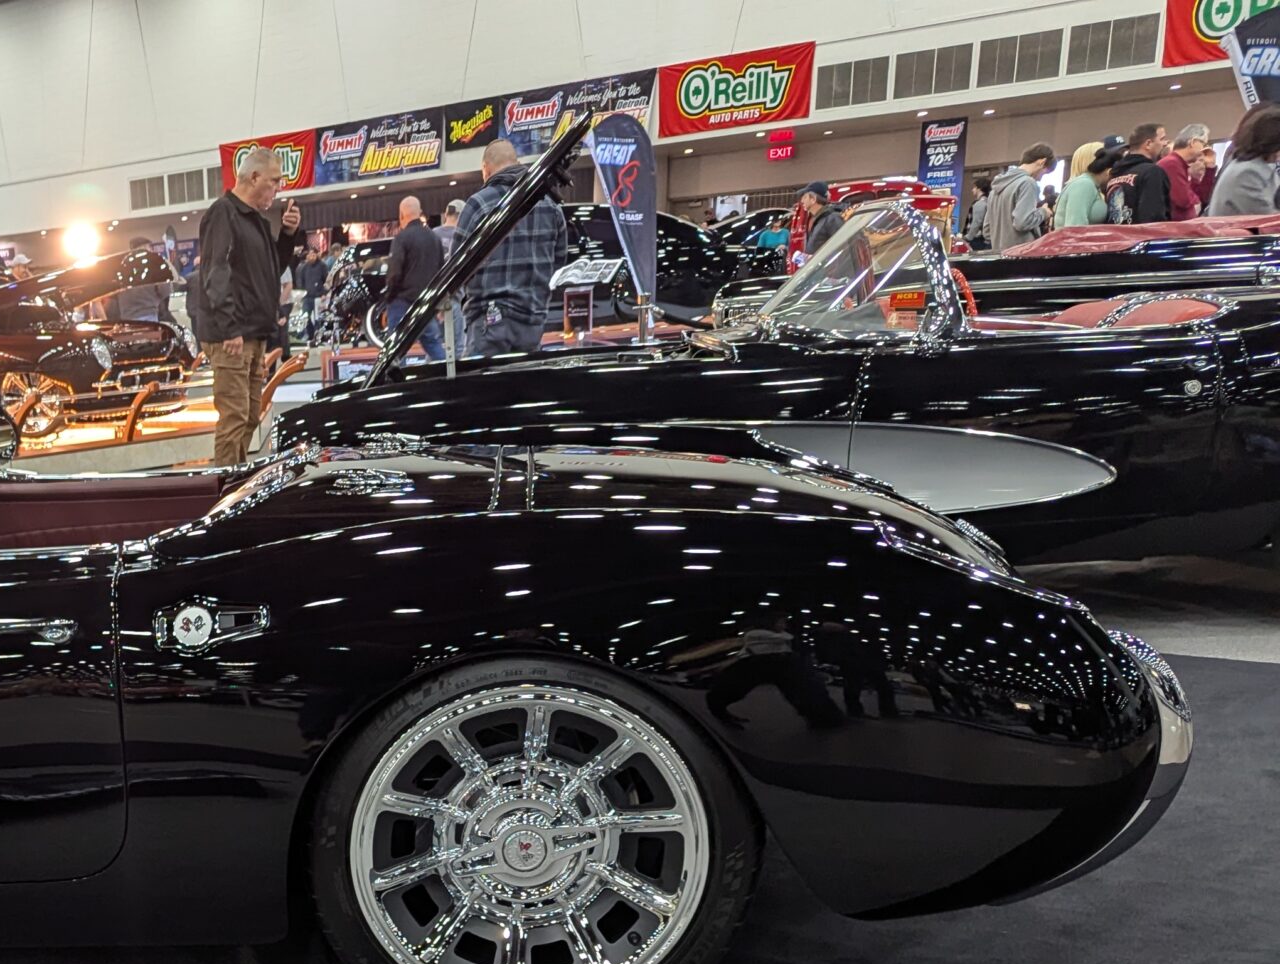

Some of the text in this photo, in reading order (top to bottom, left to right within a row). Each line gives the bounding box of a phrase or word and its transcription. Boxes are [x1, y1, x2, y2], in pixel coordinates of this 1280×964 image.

[567, 91, 601, 105] Welcomes
[618, 88, 626, 97] to
[626, 83, 641, 96] the
[683, 69, 785, 111] O'Reilly
[506, 99, 559, 124] SUMMIT
[616, 96, 648, 110] Detroit
[450, 105, 494, 143] Meguiar's
[709, 109, 760, 124] AUTO PARTS
[370, 125, 399, 139] Welcomes
[419, 118, 431, 130] the
[411, 131, 436, 143] Detroit
[322, 134, 363, 155] SUMMIT
[597, 144, 637, 165] GREAT
[770, 147, 792, 158] EXIT
[926, 145, 958, 155] SAVE
[360, 141, 439, 173] Autorama
[927, 170, 954, 178] FREE
